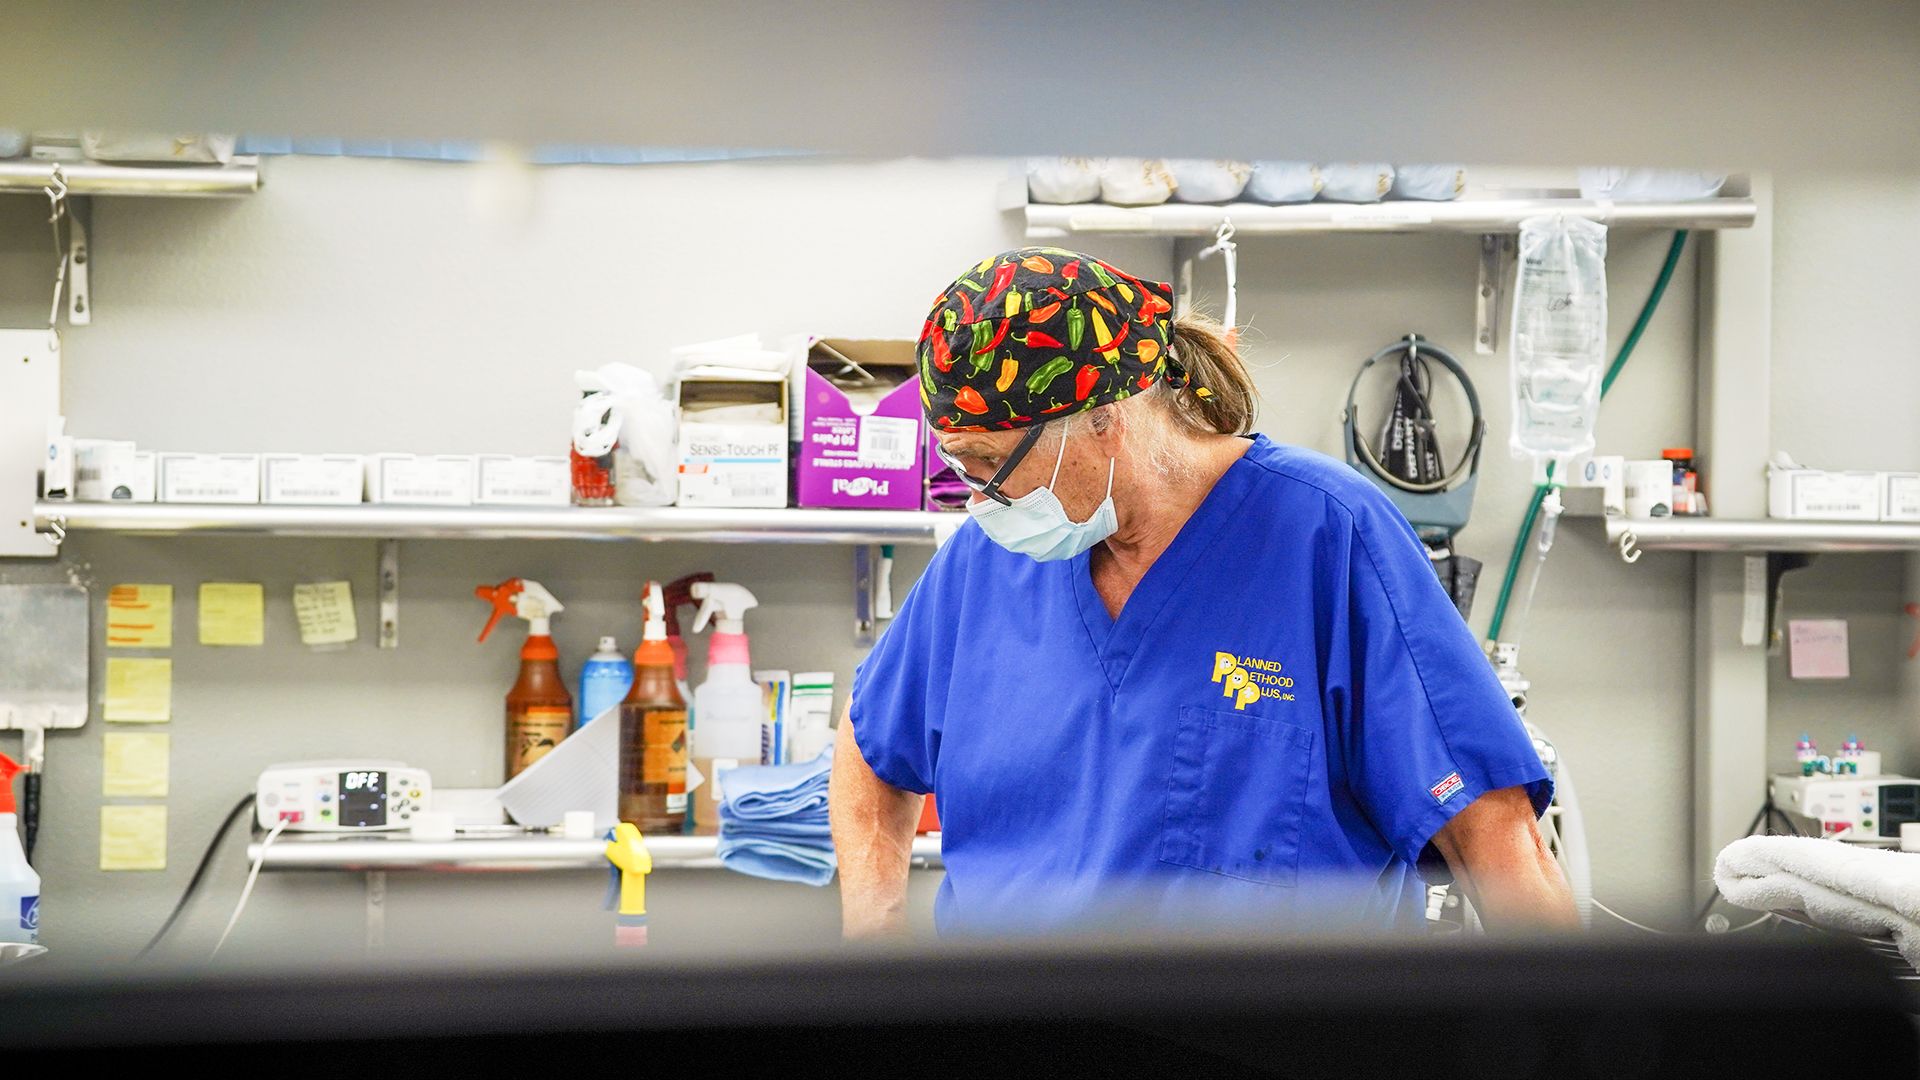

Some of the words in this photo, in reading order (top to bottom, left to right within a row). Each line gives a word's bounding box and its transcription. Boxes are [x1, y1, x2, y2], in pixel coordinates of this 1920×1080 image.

[690, 443, 766, 456] SENSI-TOUCH
[768, 443, 779, 456] PF
[1405, 416, 1417, 478] DEFIANT
[1211, 651, 1282, 683] PLANNED
[1223, 667, 1294, 698] PETHOOD
[345, 772, 379, 789] OFF
